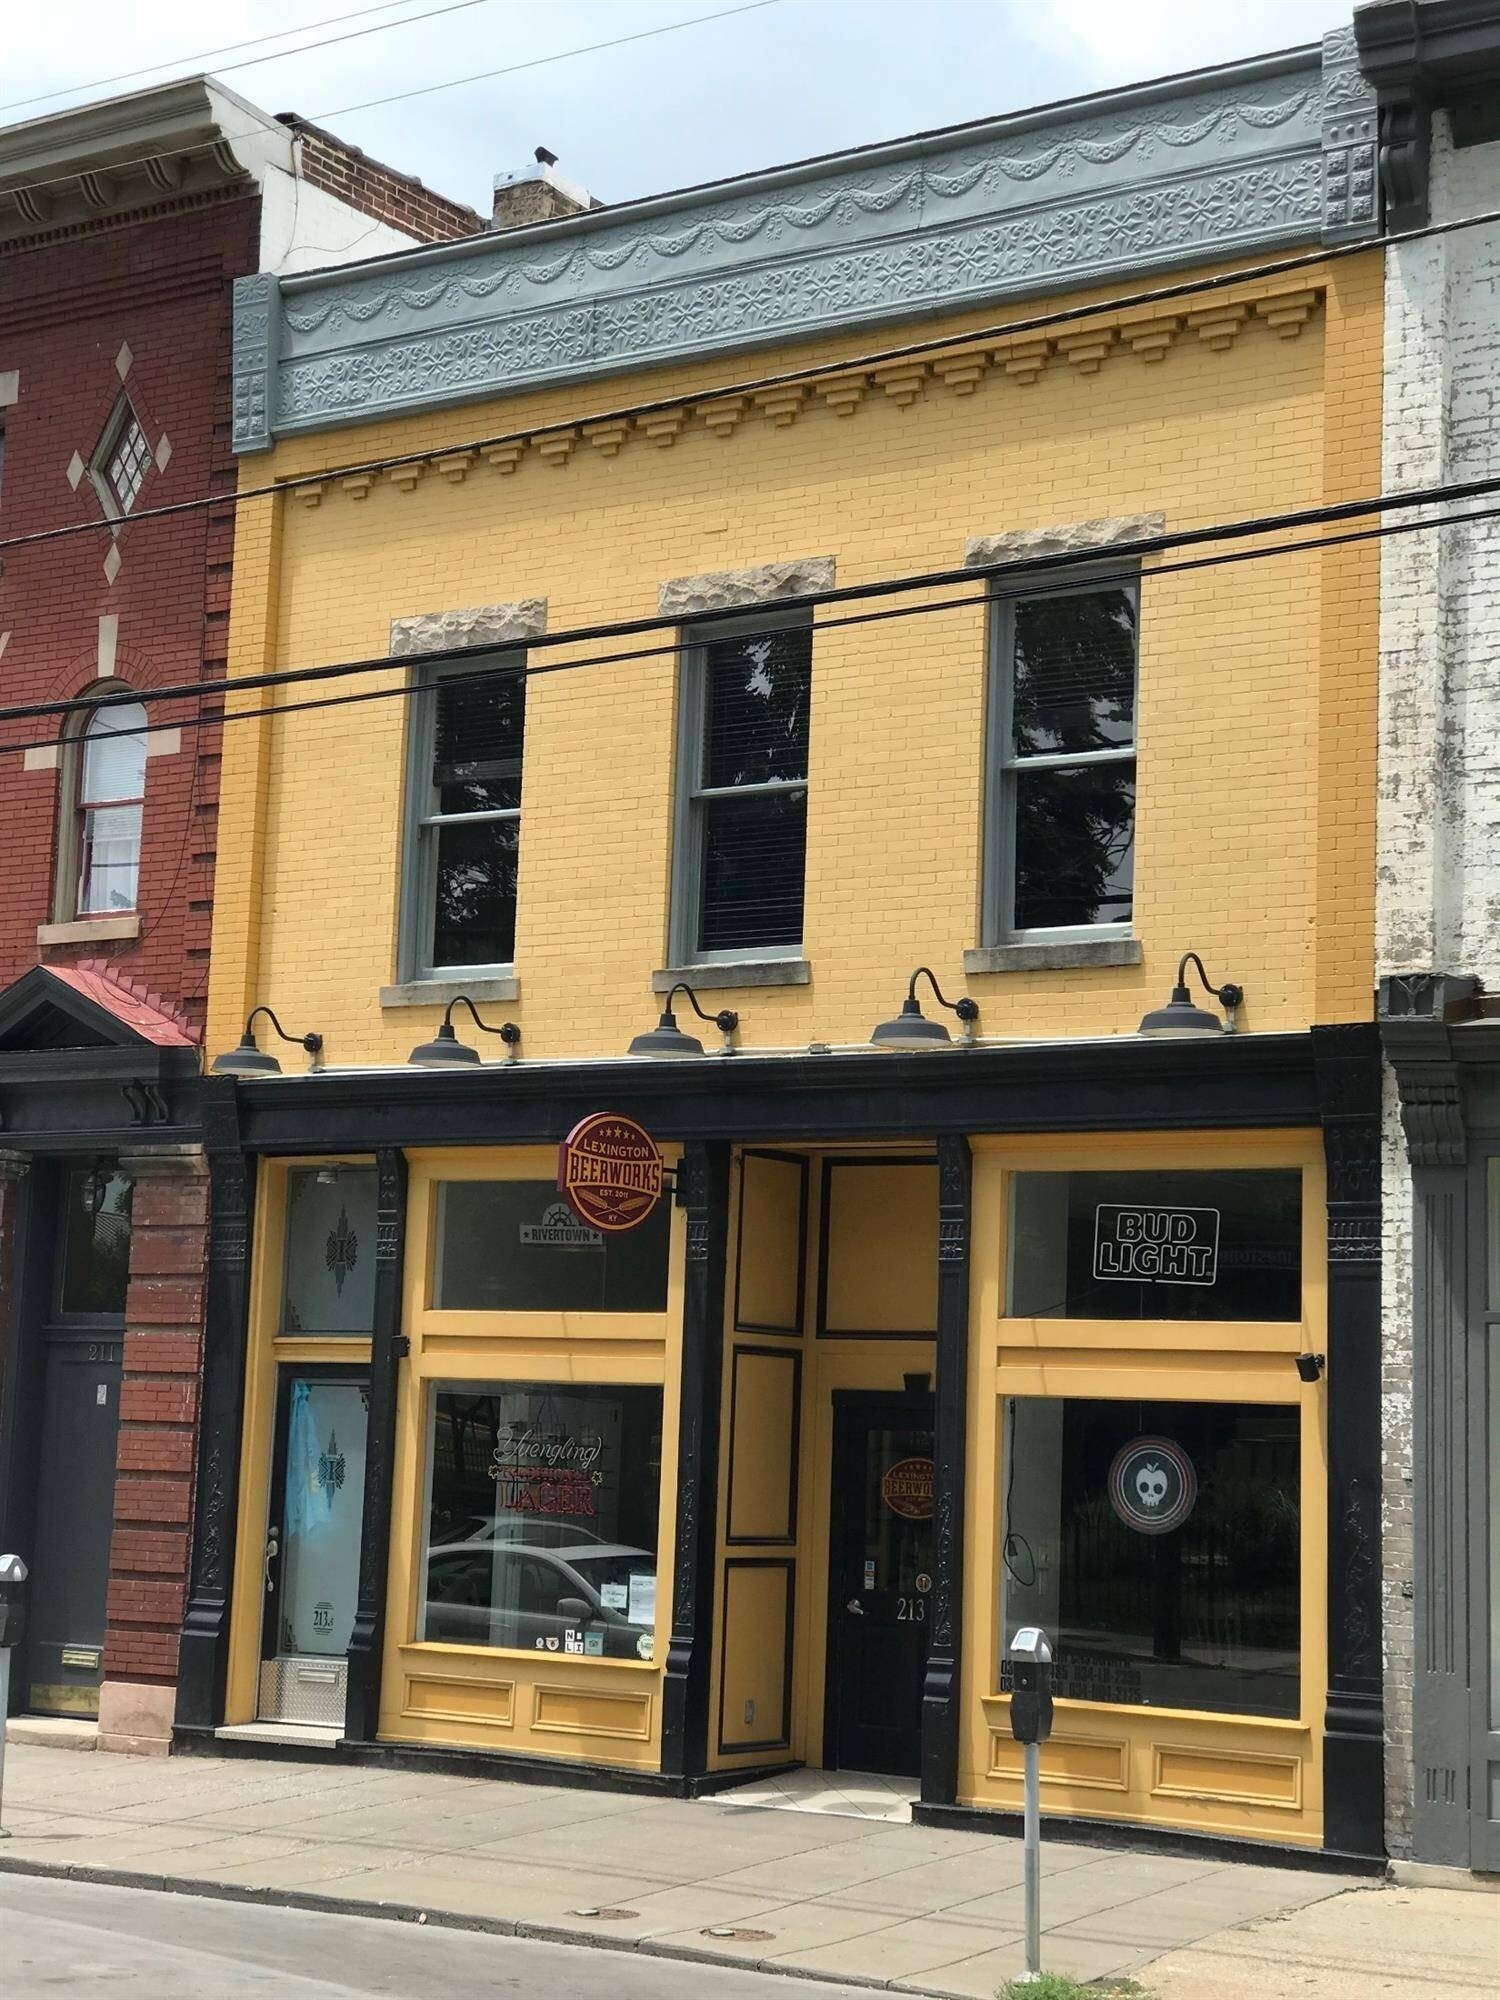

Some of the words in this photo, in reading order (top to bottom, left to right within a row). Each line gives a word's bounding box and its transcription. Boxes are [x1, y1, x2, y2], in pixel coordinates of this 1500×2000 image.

[583, 1138, 650, 1158] LEXINGTON
[569, 1152, 660, 1193] BEERWORKS
[599, 1189, 614, 1198] EST.
[608, 1214, 618, 1222] KY
[1116, 1212, 1197, 1244] BUD
[531, 1229, 590, 1242] RIVERTOWN
[1099, 1242, 1213, 1276] LIGHT
[88, 1343, 114, 1361] 211
[492, 1426, 602, 1469] Yuengling
[884, 1479, 934, 1496] BEERWO
[500, 1482, 595, 1515] LAGER
[897, 1598, 925, 1621] 213
